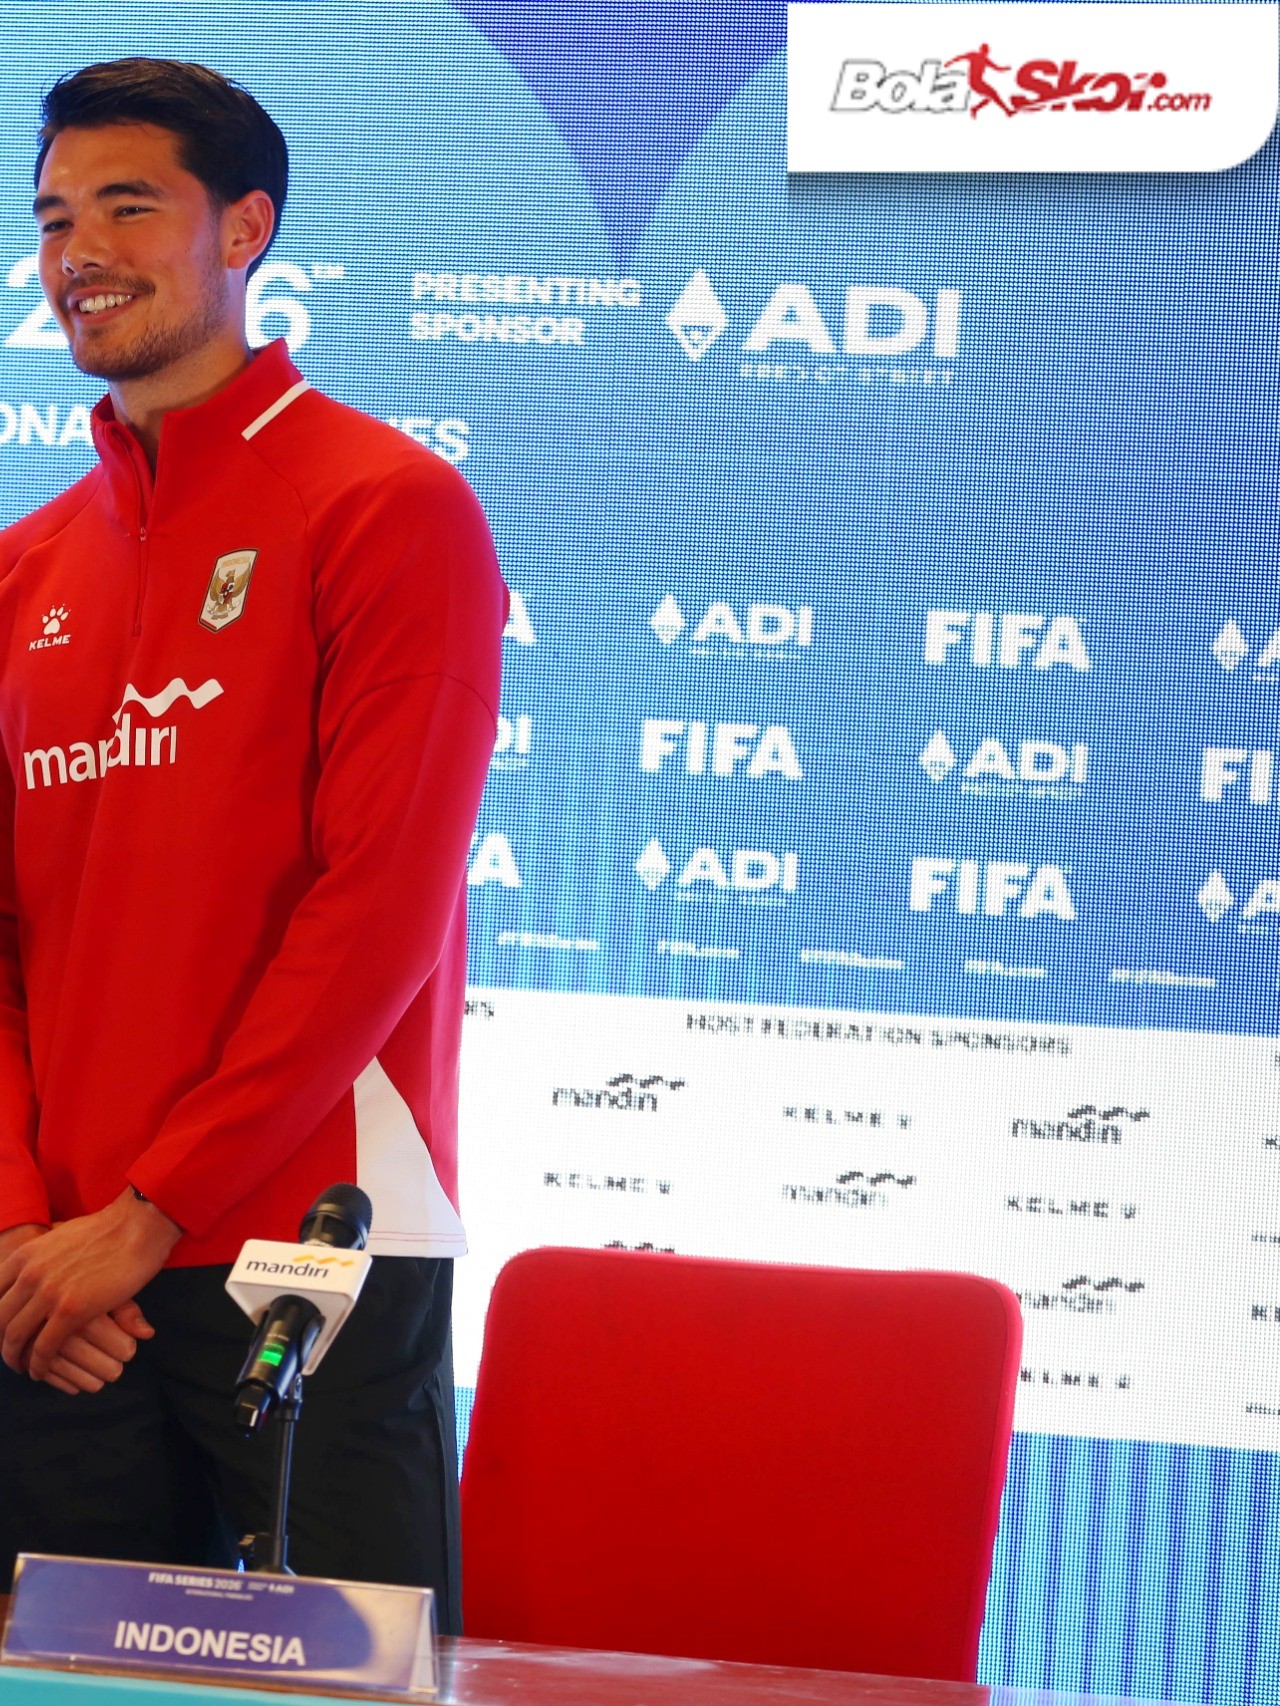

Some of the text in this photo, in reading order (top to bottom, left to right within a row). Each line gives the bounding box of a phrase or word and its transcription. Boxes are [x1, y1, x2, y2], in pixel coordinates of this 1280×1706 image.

[411, 272, 642, 307] PRESENTING
[410, 312, 585, 346] SPONSOR
[741, 283, 964, 358] ADI
[29, 634, 71, 651] KELME
[692, 600, 815, 647] ADI
[922, 609, 1092, 673] FIFA
[639, 718, 804, 781] FIFA
[961, 736, 1089, 784] ADI
[677, 846, 800, 892] ADI
[909, 856, 1078, 921] FIFA
[246, 1260, 330, 1279] mandiri
[114, 1620, 306, 1667] INDONESIA
